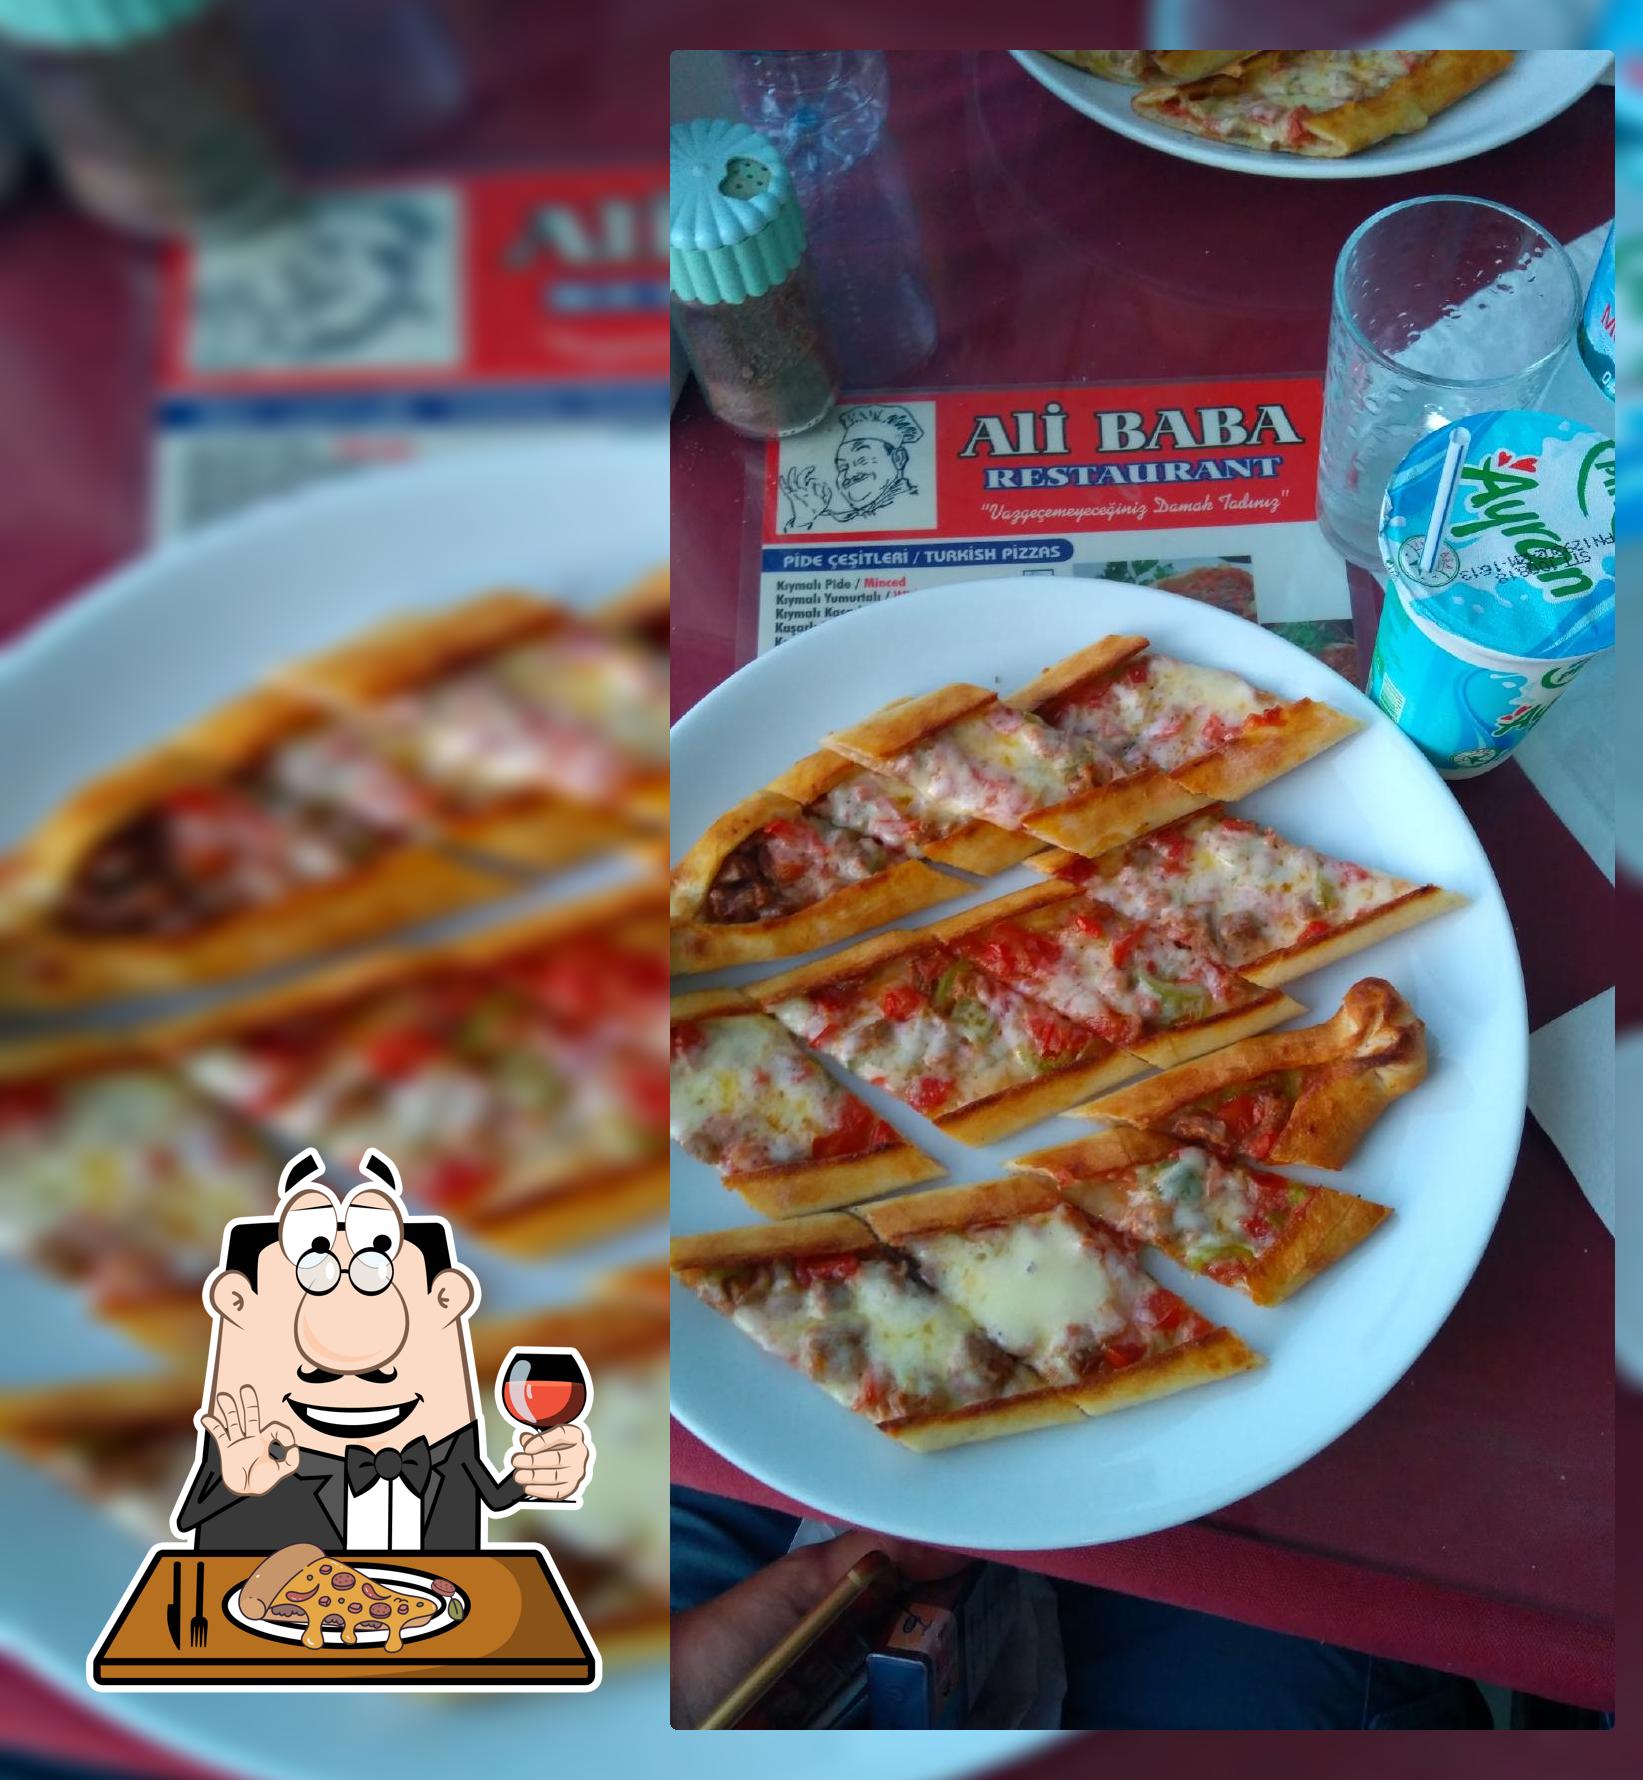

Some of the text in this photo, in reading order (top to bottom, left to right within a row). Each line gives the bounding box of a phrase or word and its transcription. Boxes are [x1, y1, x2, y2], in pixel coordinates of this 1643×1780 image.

[958, 402, 1305, 458] Ali BABA
[985, 456, 1282, 489] RESTAURANT
[1153, 494, 1214, 513] Damak
[1450, 456, 1593, 598] Ayran
[776, 579, 821, 593] Kıymalı
[825, 578, 851, 590] Pide
[864, 576, 906, 589] Minced
[776, 593, 821, 606] Kıymalı
[775, 606, 820, 620] Kıymalı
